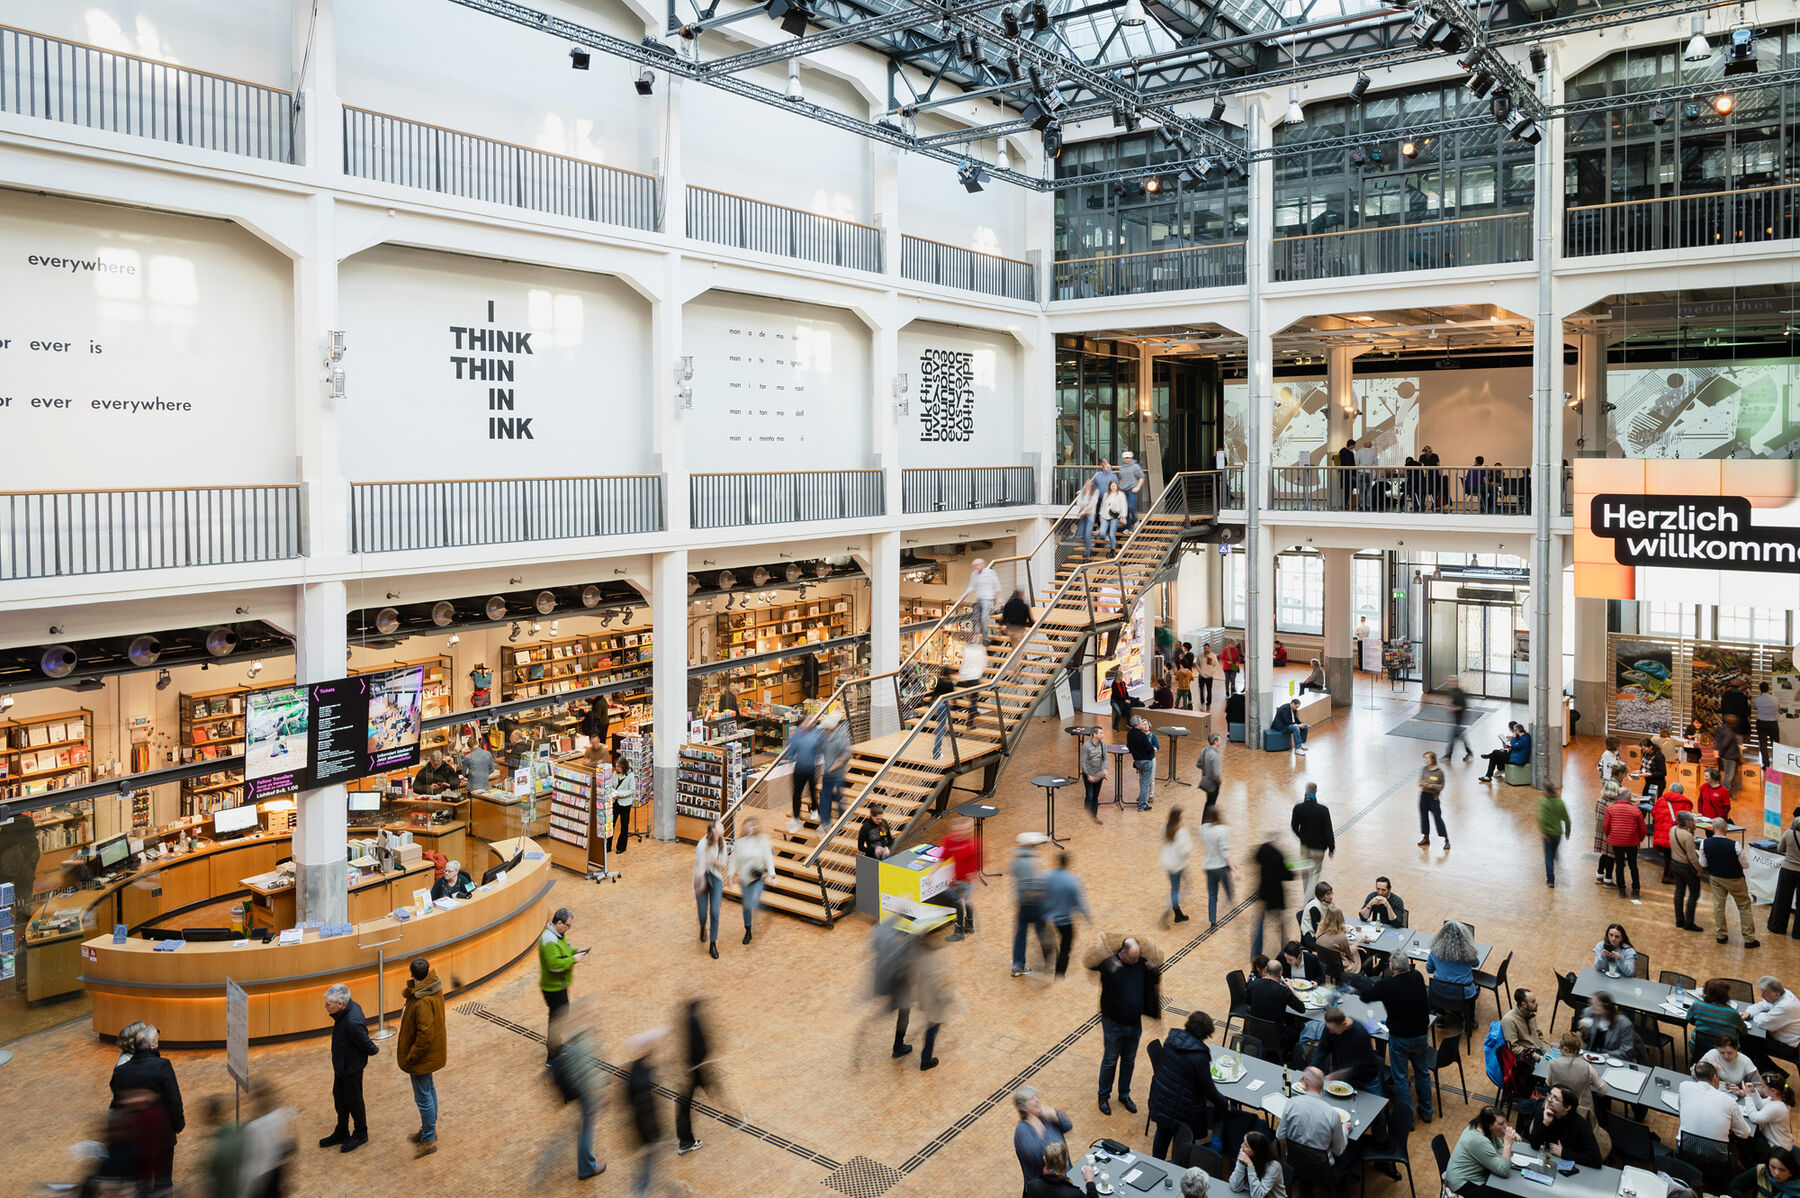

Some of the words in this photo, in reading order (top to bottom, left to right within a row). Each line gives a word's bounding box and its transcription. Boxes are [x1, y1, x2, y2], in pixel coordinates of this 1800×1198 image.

[28, 250, 136, 275] everywhere
[488, 300, 494, 323] I
[30, 340, 71, 352] ever
[90, 340, 102, 354] is
[450, 326, 533, 354] THINK
[450, 356, 515, 382] THIN
[31, 398, 72, 408] ever
[91, 394, 192, 414] everywhere
[488, 388, 515, 410] IN
[488, 417, 534, 440] INK
[1604, 504, 1738, 532] Herzlich
